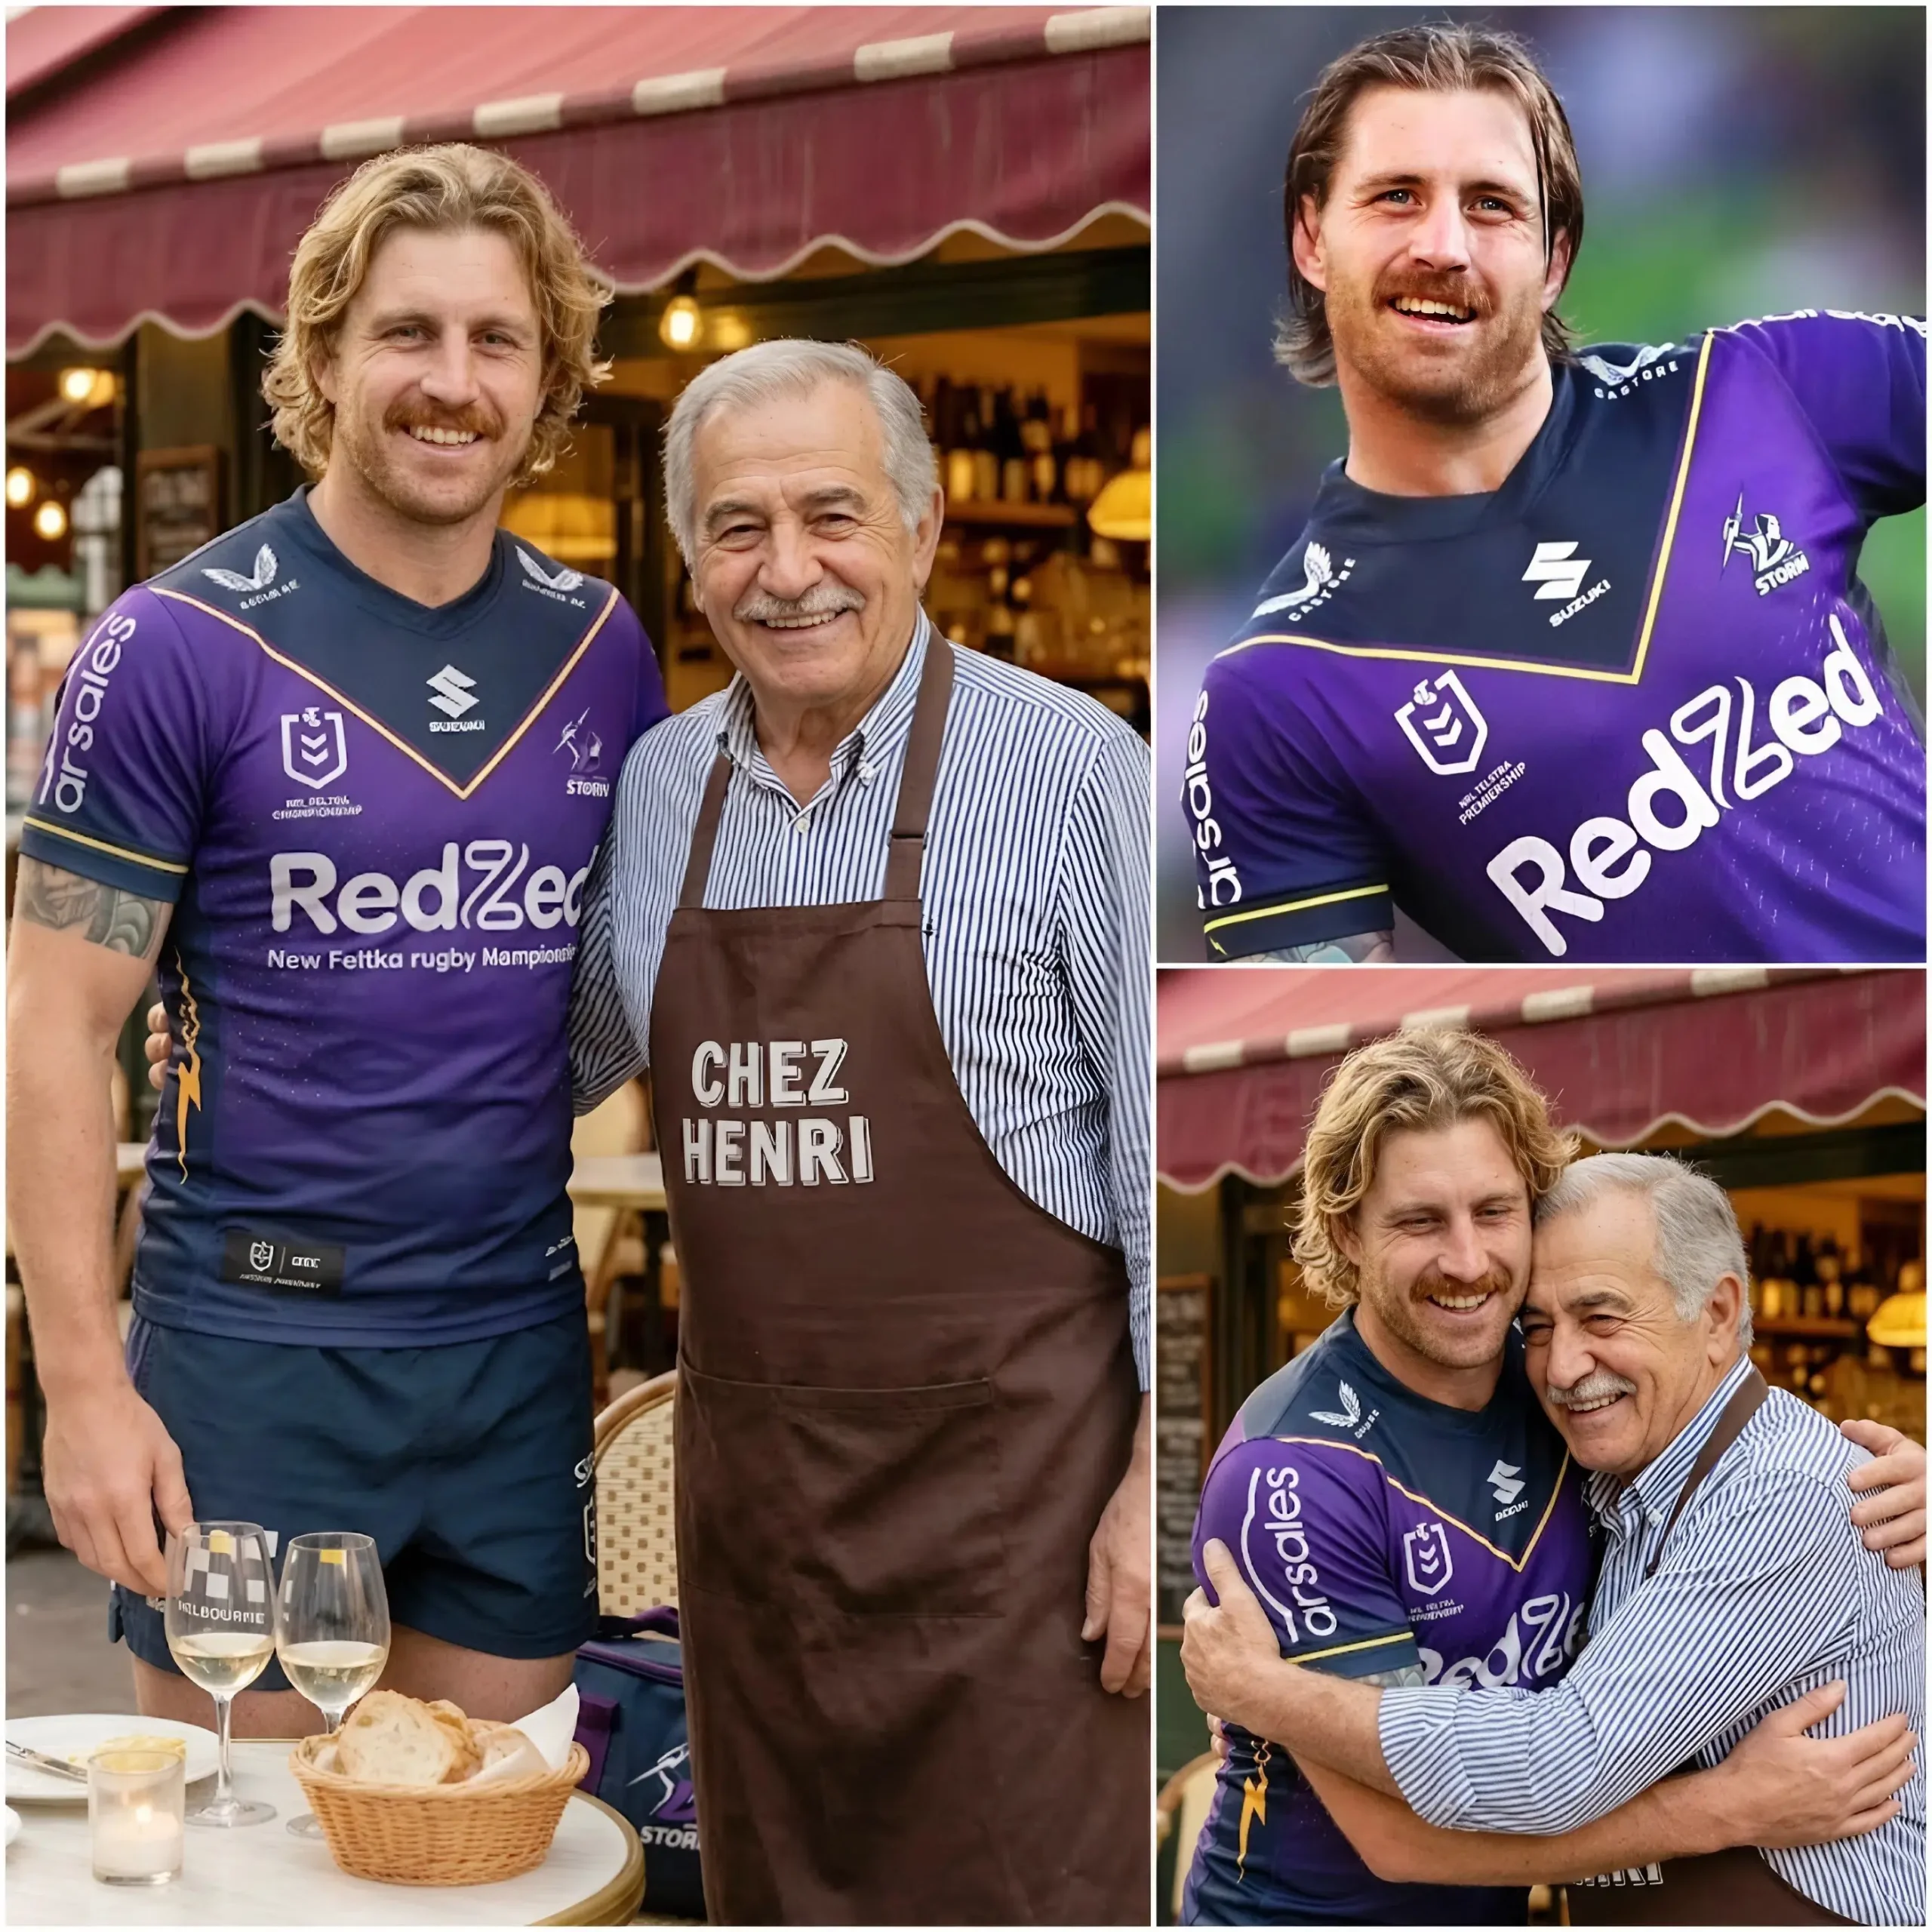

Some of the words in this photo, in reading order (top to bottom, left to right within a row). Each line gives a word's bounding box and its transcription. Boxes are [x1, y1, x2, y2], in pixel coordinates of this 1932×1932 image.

[1549, 579, 1611, 627] SUZUKI
[1755, 553, 1810, 596] STORM
[54, 615, 137, 814] arsales
[1458, 761, 1526, 826] PREMIERSHIP
[1486, 613, 1884, 957] RedZed
[267, 949, 321, 969] New
[411, 947, 476, 974] rugby
[691, 1038, 850, 1109] CHEZ
[681, 1115, 875, 1187] HENRI
[1263, 1466, 1337, 1637] arsales
[640, 1825, 701, 1850] STOR
